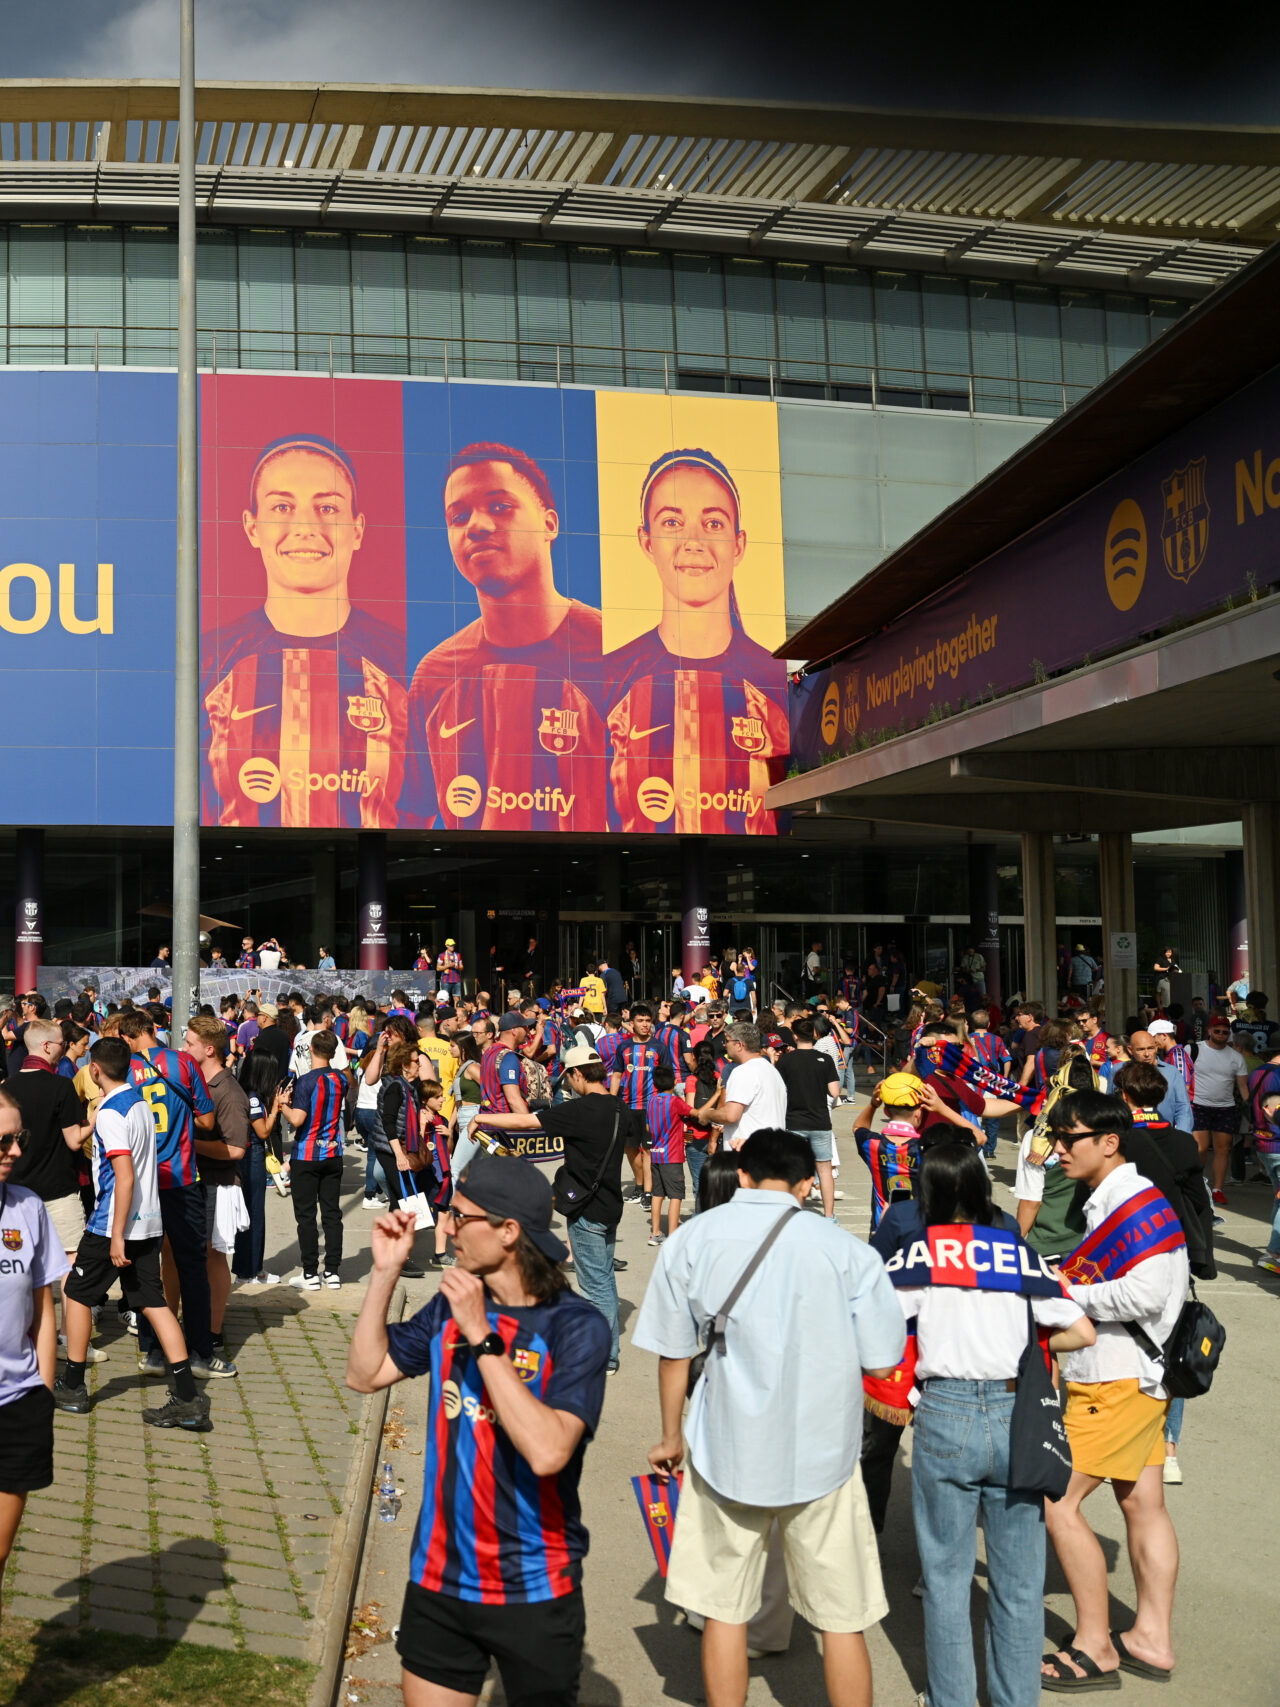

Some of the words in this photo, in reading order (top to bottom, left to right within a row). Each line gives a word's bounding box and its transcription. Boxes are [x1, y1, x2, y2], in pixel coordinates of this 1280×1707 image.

[1175, 511, 1193, 532] FCB
[866, 672, 892, 712] Now
[893, 646, 935, 707] playing
[935, 613, 998, 680] together
[551, 727, 568, 735] FCB
[287, 768, 380, 798] Spotify
[486, 786, 575, 817] Spotify
[680, 788, 762, 818] Spotify
[142, 1082, 169, 1134] 6
[510, 1136, 565, 1155] RCELO
[880, 1153, 917, 1168] PEDRI
[462, 1396, 499, 1424] Spo
